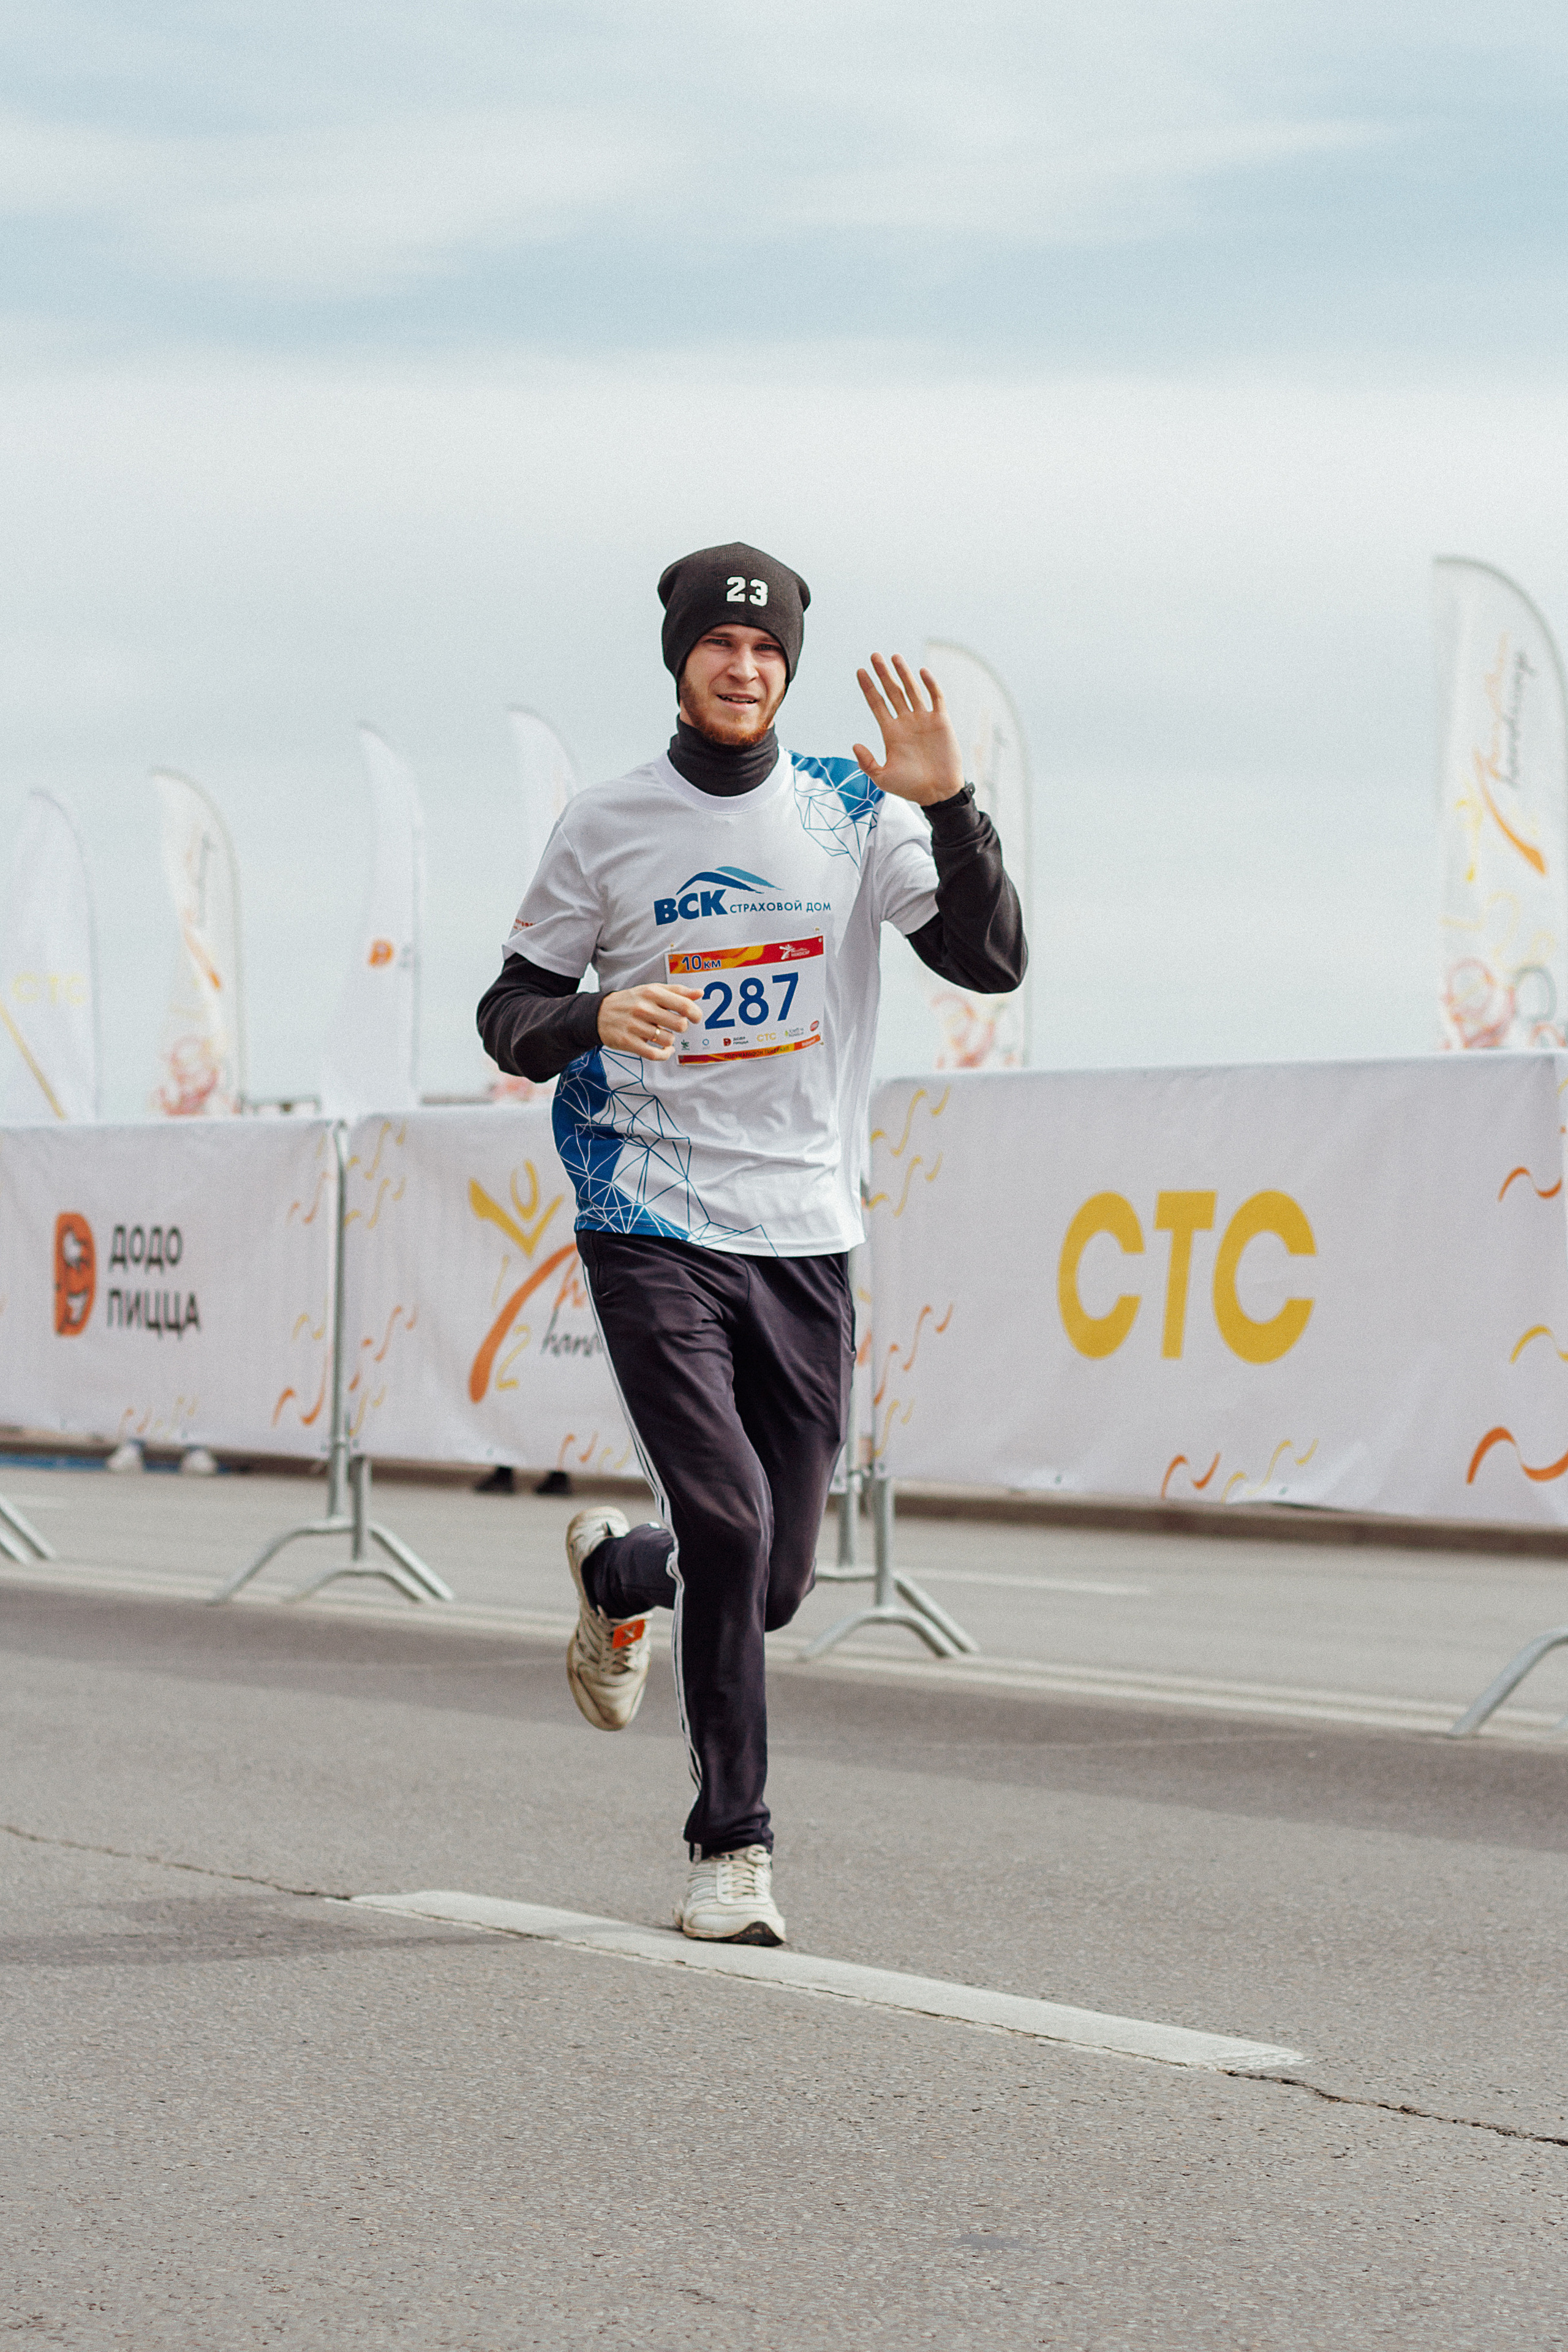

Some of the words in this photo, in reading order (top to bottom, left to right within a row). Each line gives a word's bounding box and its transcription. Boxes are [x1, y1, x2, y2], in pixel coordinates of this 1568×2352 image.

[726, 576, 768, 606] 23
[654, 889, 728, 925] ВСК
[729, 900, 802, 913] СТРАХОВОЙ
[806, 902, 831, 913] ДОМ
[702, 972, 799, 1030] 287
[756, 1033, 777, 1042] СТС
[108, 1224, 183, 1274] ДОДО
[1057, 1189, 1317, 1365] СТС
[106, 1288, 201, 1340] ПИЦЦА
